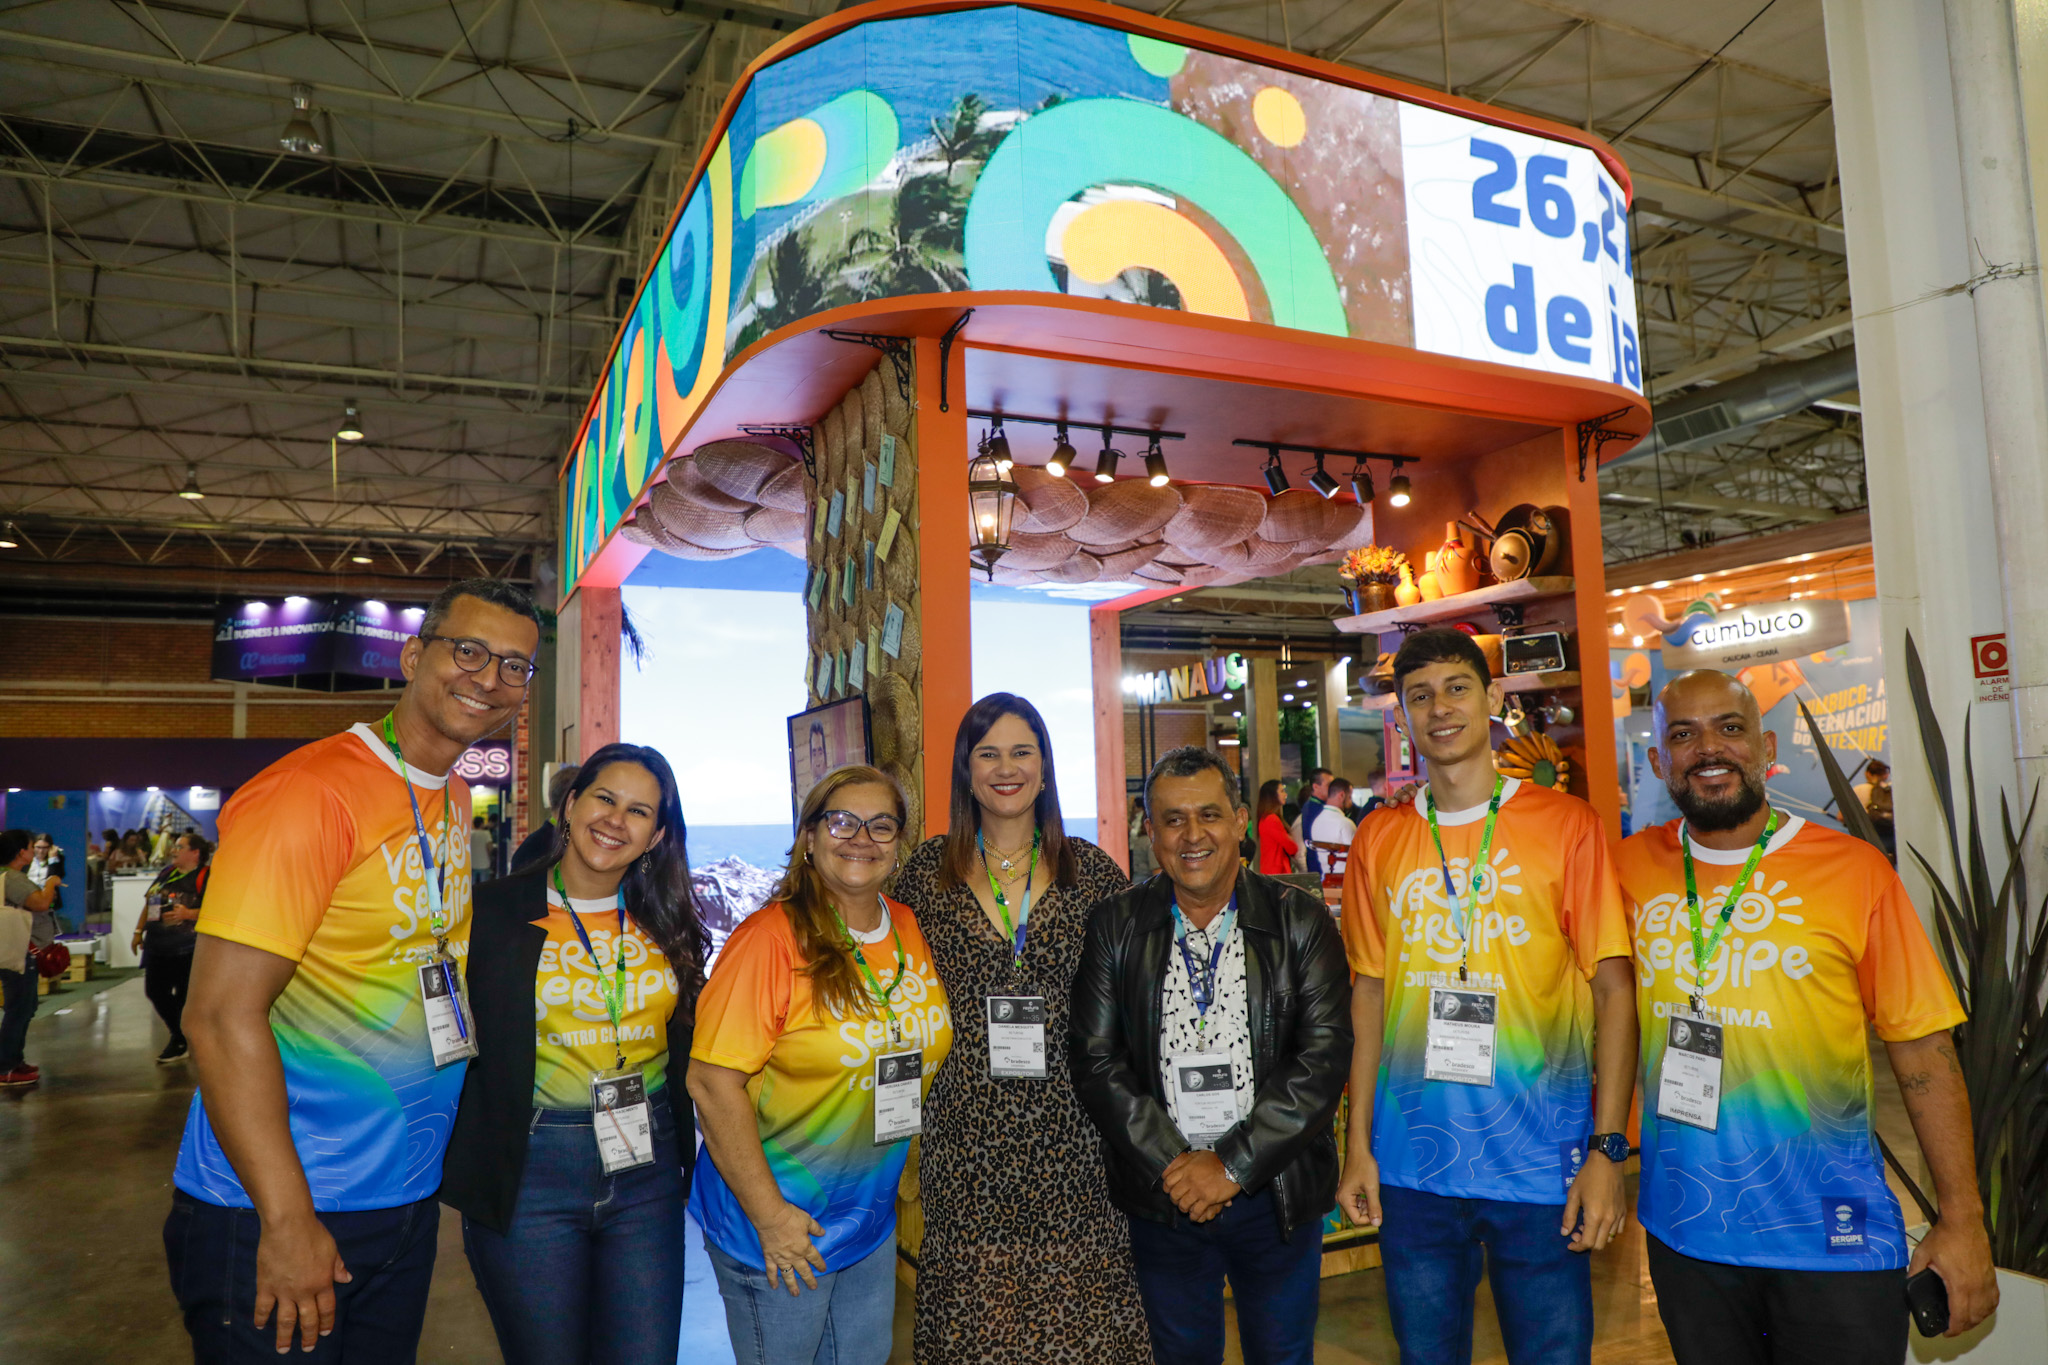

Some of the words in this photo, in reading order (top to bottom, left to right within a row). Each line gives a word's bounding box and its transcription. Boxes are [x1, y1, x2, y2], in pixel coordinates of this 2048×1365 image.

[1484, 262, 1592, 365] de
[234, 626, 272, 640] BUSINESS
[273, 627, 279, 637] &
[280, 622, 335, 636] INNOVATION
[356, 625, 393, 640] BUSINESS
[394, 631, 399, 642] &
[1692, 613, 1803, 645] cumbuco
[1135, 652, 1246, 706] MANAUS
[453, 747, 510, 779] SS
[547, 1027, 597, 1048] OUTRO
[600, 1024, 656, 1044] CLIMA
[1680, 1094, 1702, 1105] bradesco
[1670, 1107, 1702, 1121] IMPRENSA
[1830, 1234, 1863, 1244] SERGIPE
